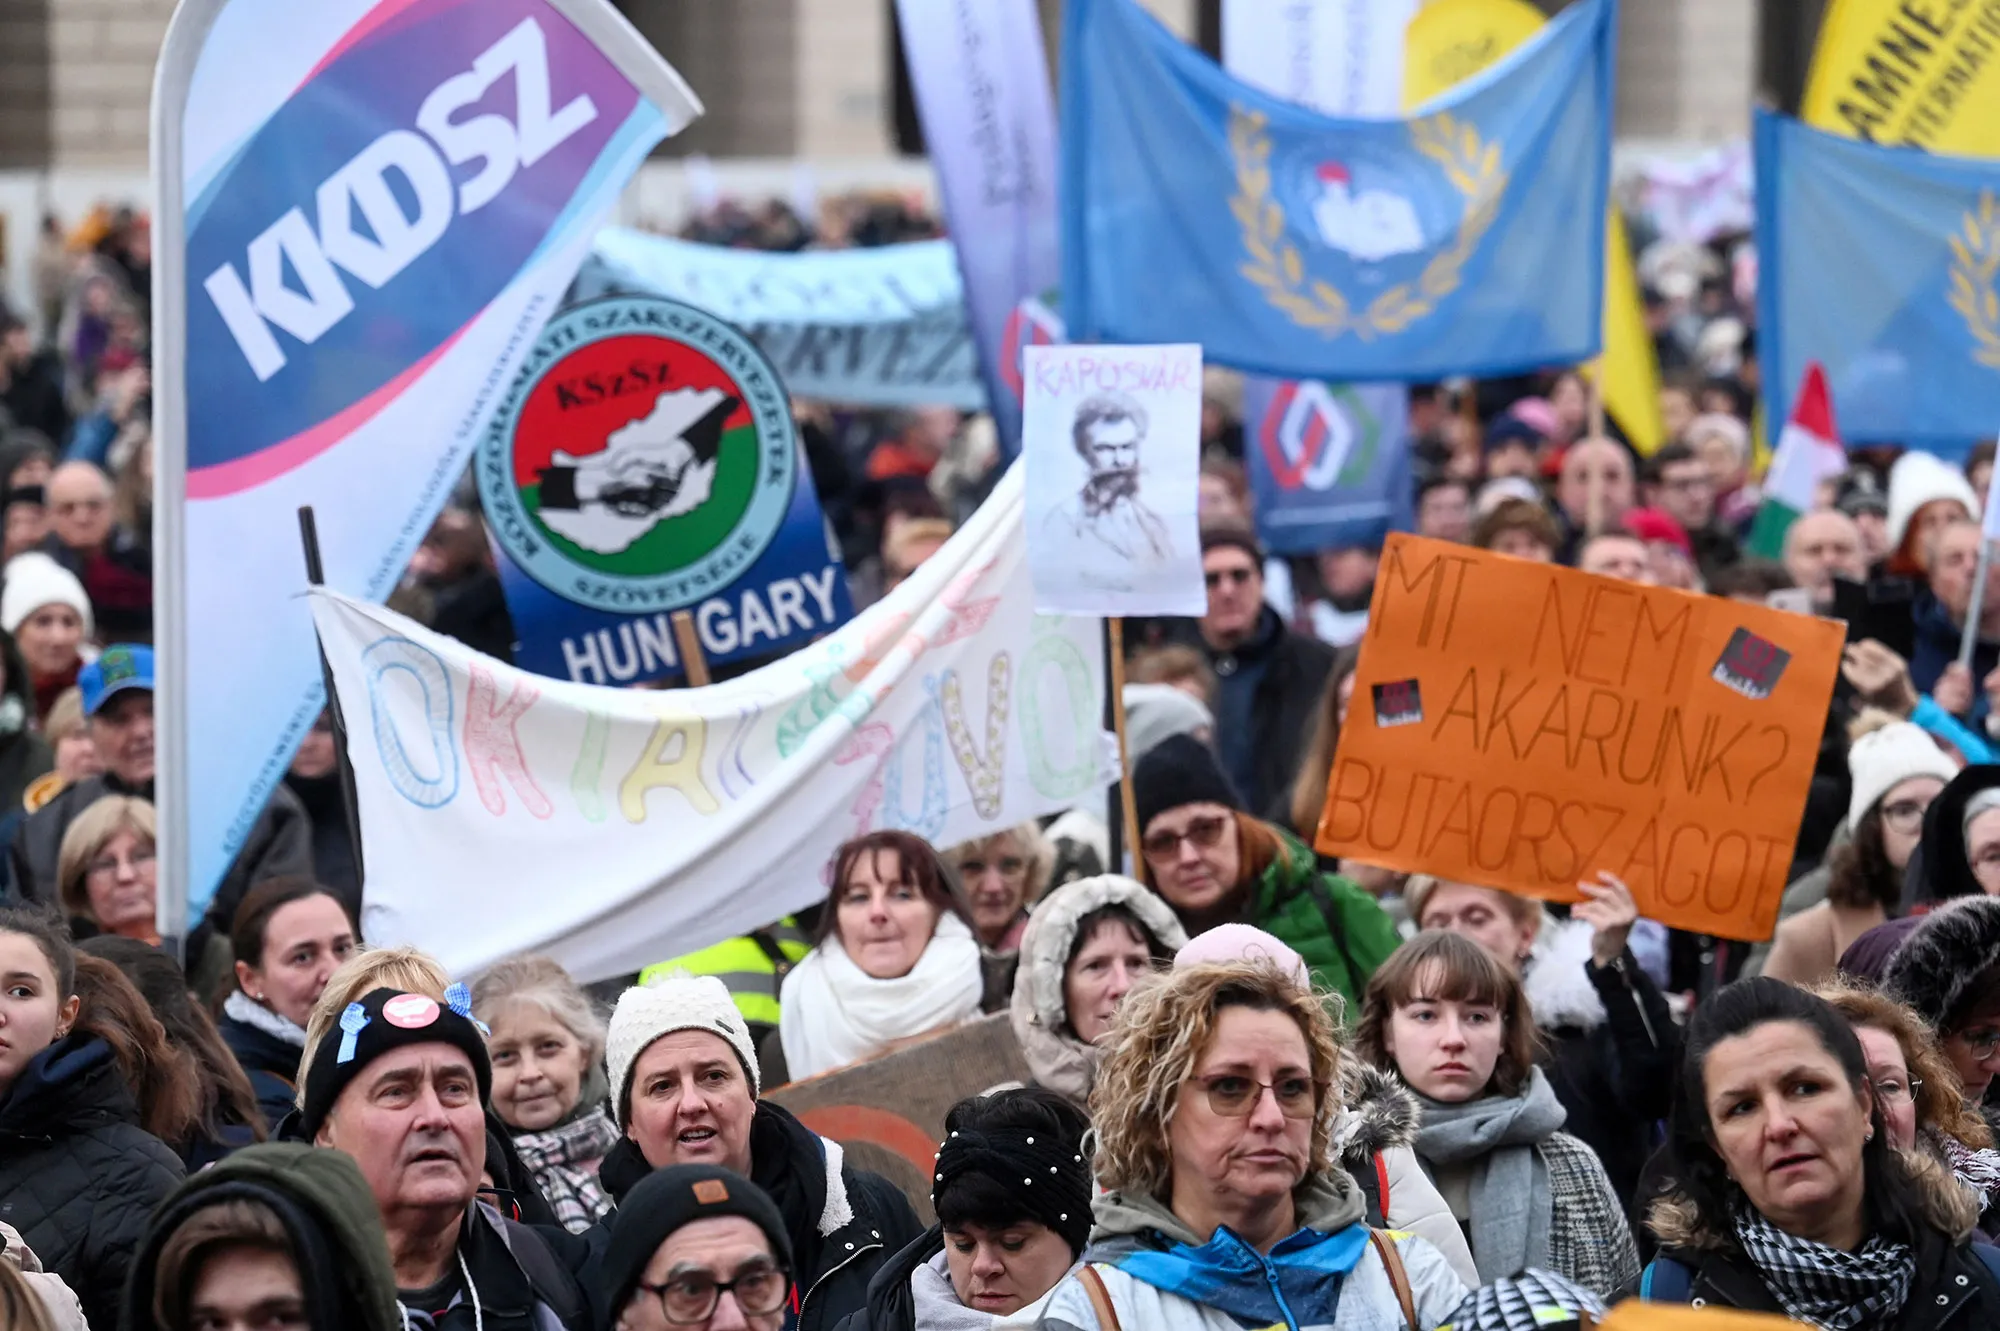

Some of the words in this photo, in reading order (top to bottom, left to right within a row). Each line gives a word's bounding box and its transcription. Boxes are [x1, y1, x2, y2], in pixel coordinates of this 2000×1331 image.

[1836, 0, 1968, 144] AMNE
[203, 16, 599, 382] KKDSZ
[560, 565, 837, 684] HUNGARY
[1528, 577, 1693, 695] NEM
[1431, 666, 1791, 806] AKARUNK?
[1324, 757, 1792, 922] BUTAORSZÁGOT
